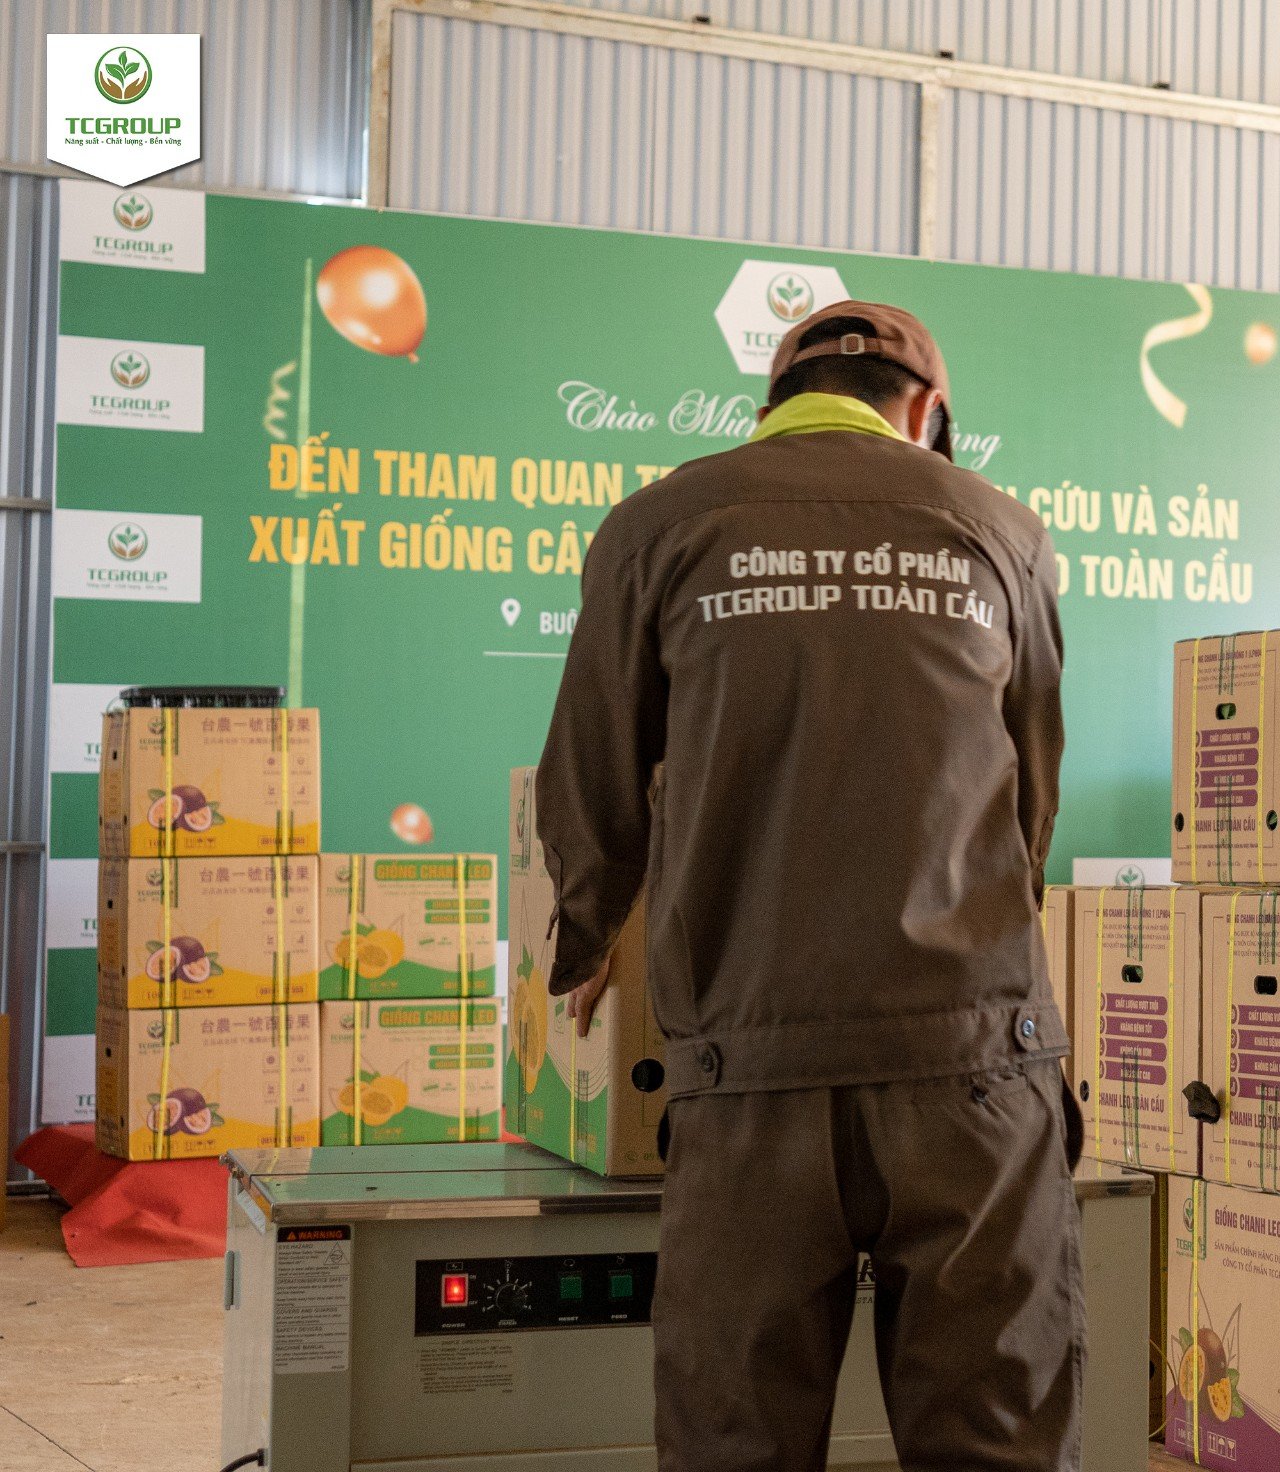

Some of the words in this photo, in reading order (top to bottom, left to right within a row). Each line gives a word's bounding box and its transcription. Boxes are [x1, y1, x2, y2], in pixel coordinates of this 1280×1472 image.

[93, 235, 173, 254] TCGROUP
[90, 395, 170, 411] TCGROUP
[557, 380, 658, 432] Chào
[269, 432, 359, 493] ĐẾN
[375, 450, 496, 500] THAM
[511, 458, 623, 509] QUAN
[1029, 480, 1101, 533] CỨU
[1112, 486, 1157, 537] VÀ
[1169, 484, 1239, 540] SẢN
[248, 502, 366, 565] XUẤT
[380, 509, 513, 572] GIỐNG
[527, 520, 595, 575] CÂ
[1081, 548, 1174, 601] TOÀN
[1185, 548, 1253, 604] CẦU
[729, 545, 807, 579] CÔNG
[813, 550, 846, 575] TY
[854, 542, 892, 575] CỔ
[899, 548, 971, 585] PHẦN
[87, 568, 167, 582] TCGROUP
[697, 585, 842, 623] TCGROUP
[850, 581, 937, 615] TOÀN
[946, 589, 994, 629] CẦU
[540, 608, 580, 635] BUÔ
[421, 864, 458, 879] CHAN
[298, 1230, 343, 1240] WARNING
[1240, 1213, 1266, 1235] CHANH
